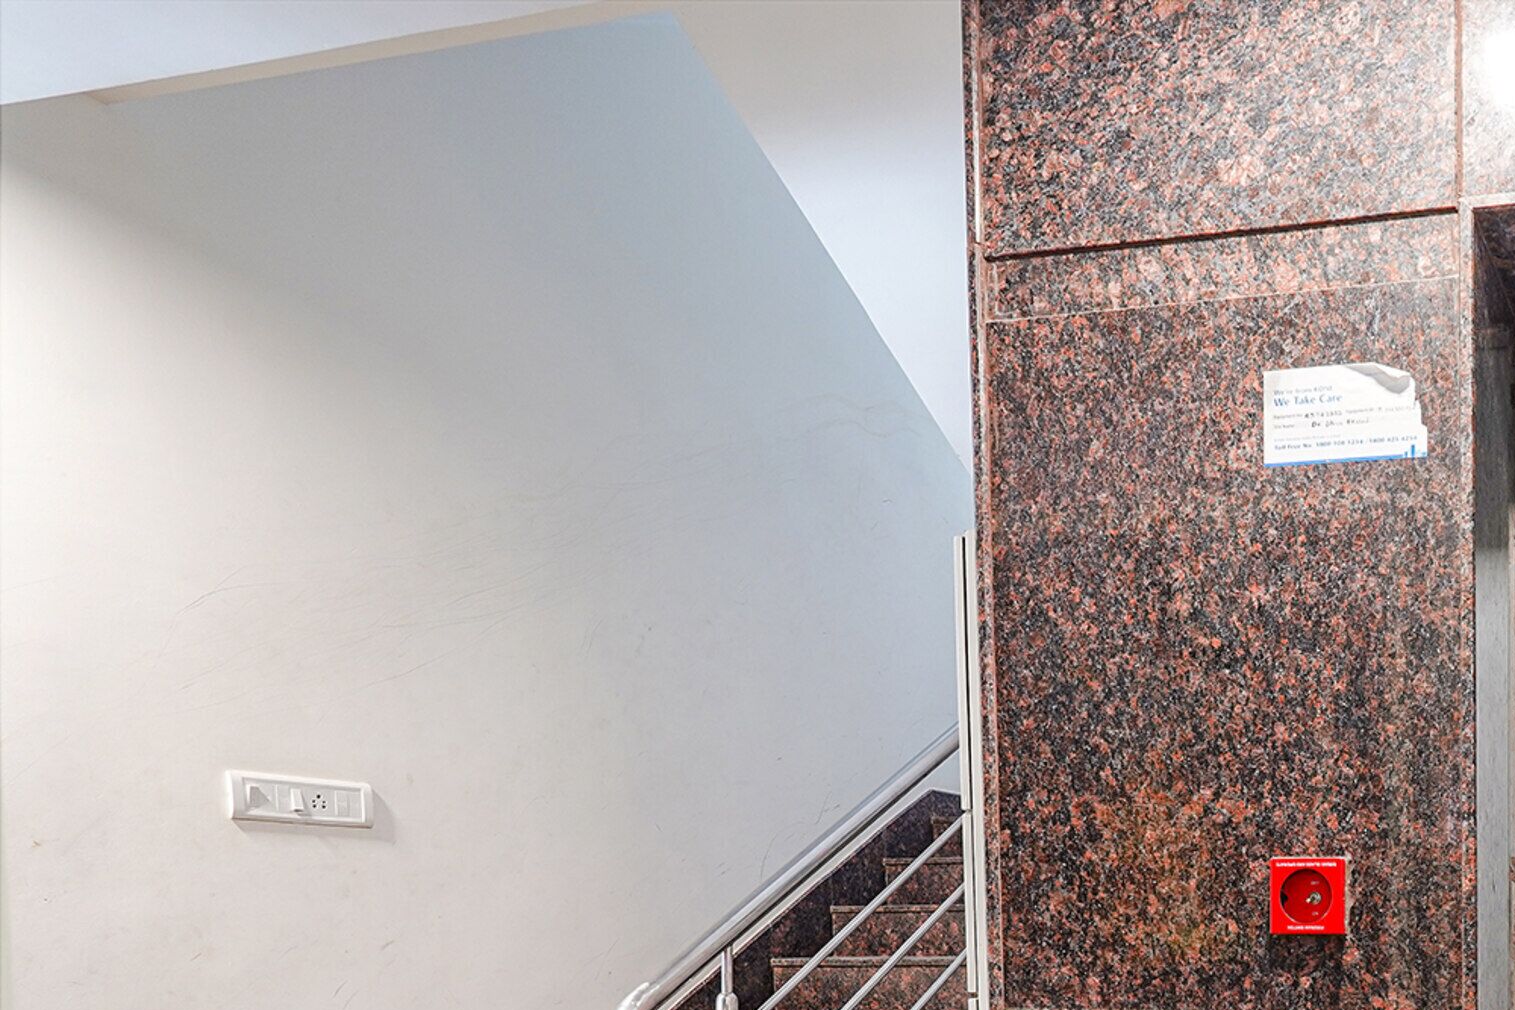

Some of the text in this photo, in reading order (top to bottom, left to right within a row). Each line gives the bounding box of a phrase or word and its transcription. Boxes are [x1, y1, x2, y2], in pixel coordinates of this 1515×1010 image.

[1273, 397, 1289, 407] We
[1294, 394, 1315, 405] Take
[1319, 391, 1342, 402] Care
